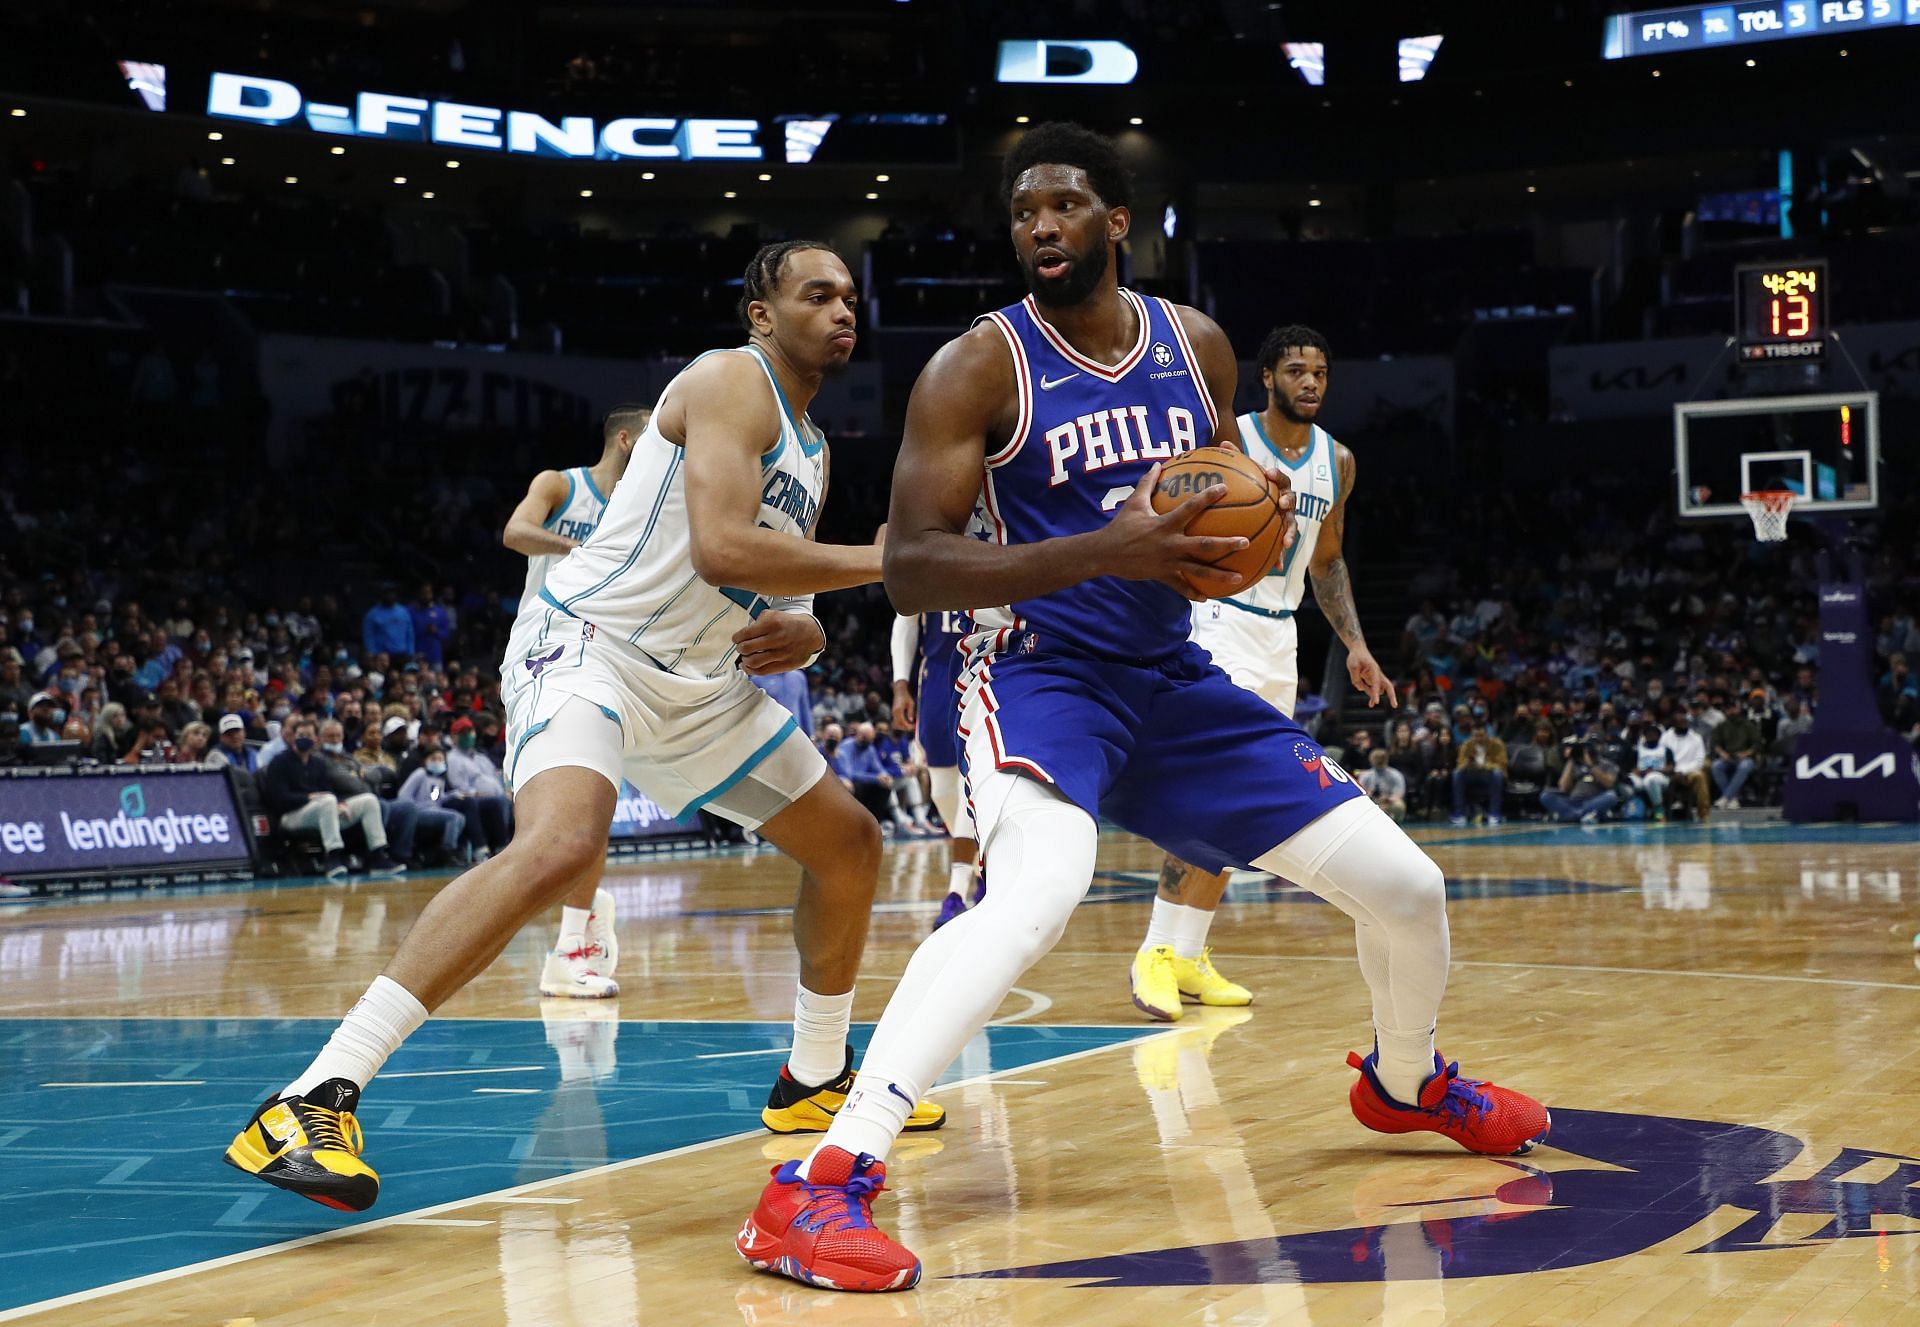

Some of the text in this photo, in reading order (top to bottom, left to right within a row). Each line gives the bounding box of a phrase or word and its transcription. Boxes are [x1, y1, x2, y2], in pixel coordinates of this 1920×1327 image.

[1738, 11, 1783, 32] TOL
[1788, 5, 1807, 28] 3
[1822, 1, 1864, 23] FLS
[998, 40, 1139, 84] D
[207, 72, 763, 160] D-FENCE
[1763, 270, 1816, 295] 4:24
[1772, 296, 1809, 336] 13
[1765, 342, 1823, 357] TISSOT
[1150, 369, 1187, 380] crypto.com
[1044, 405, 1196, 487] PHILA
[60, 808, 231, 853] lendingtree
